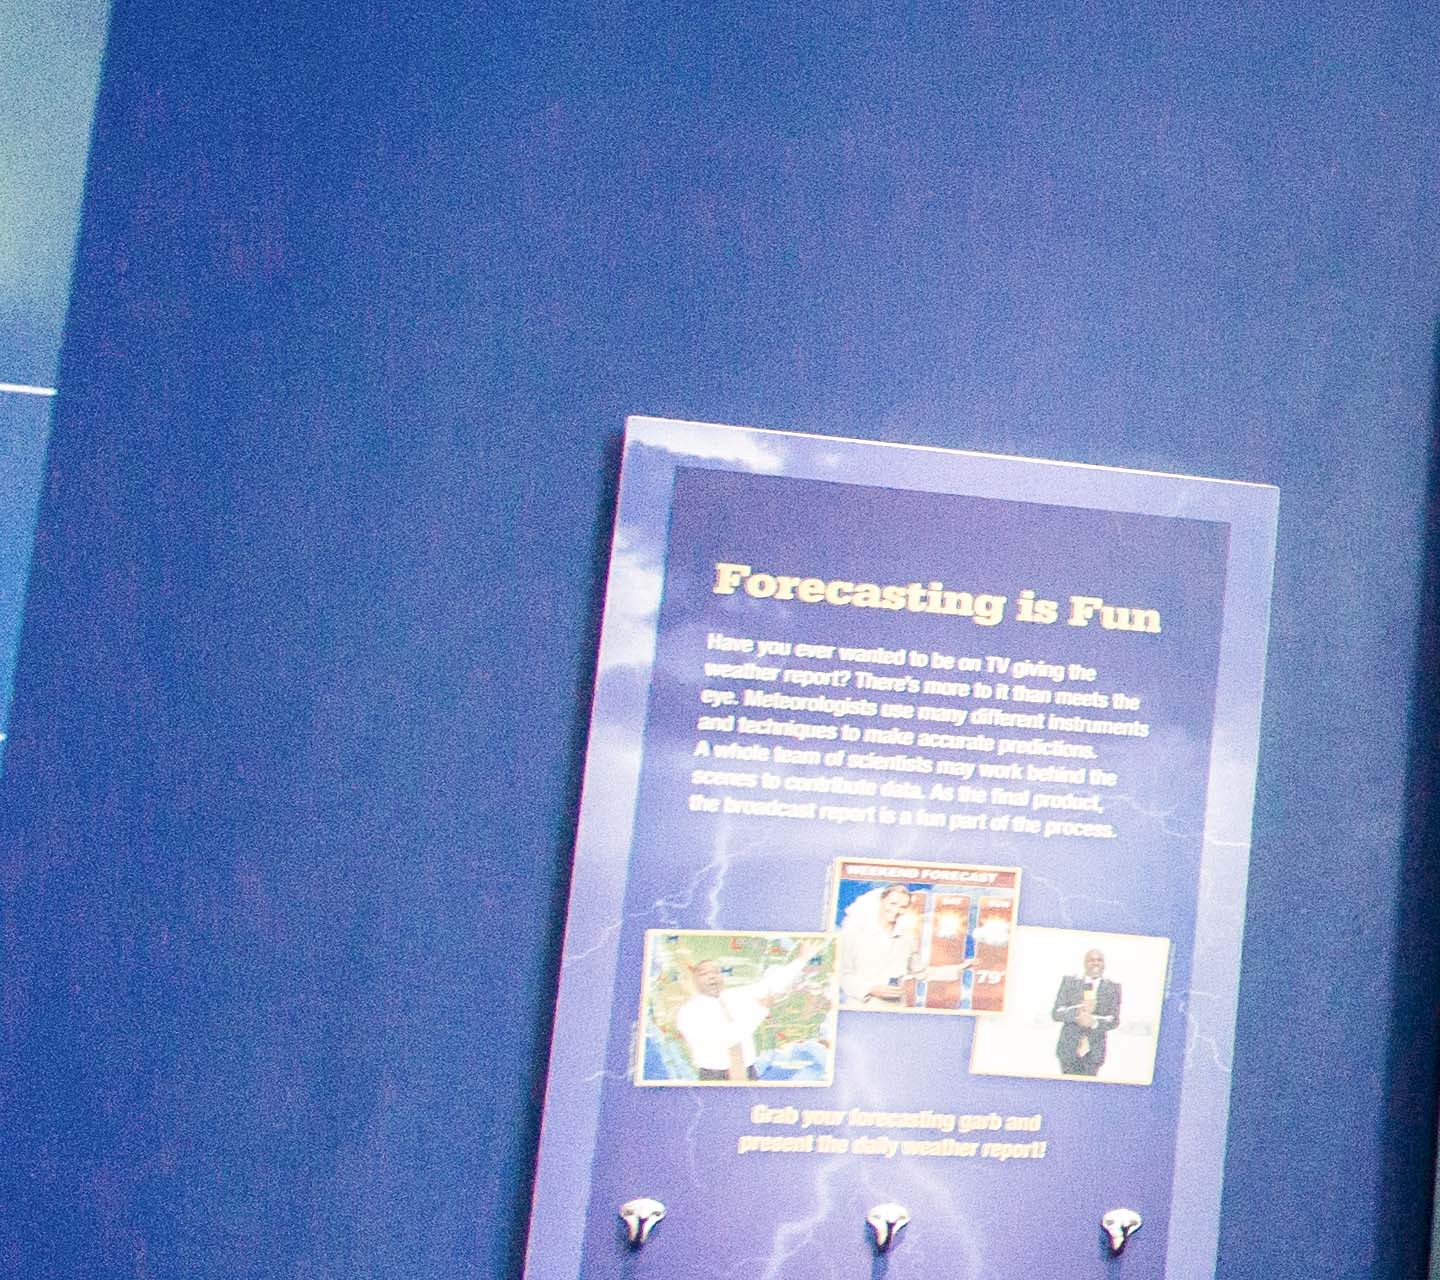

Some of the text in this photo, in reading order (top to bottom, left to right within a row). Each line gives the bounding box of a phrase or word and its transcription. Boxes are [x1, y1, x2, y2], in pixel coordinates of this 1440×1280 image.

[713, 563, 1162, 633] Forecasting is Fun
